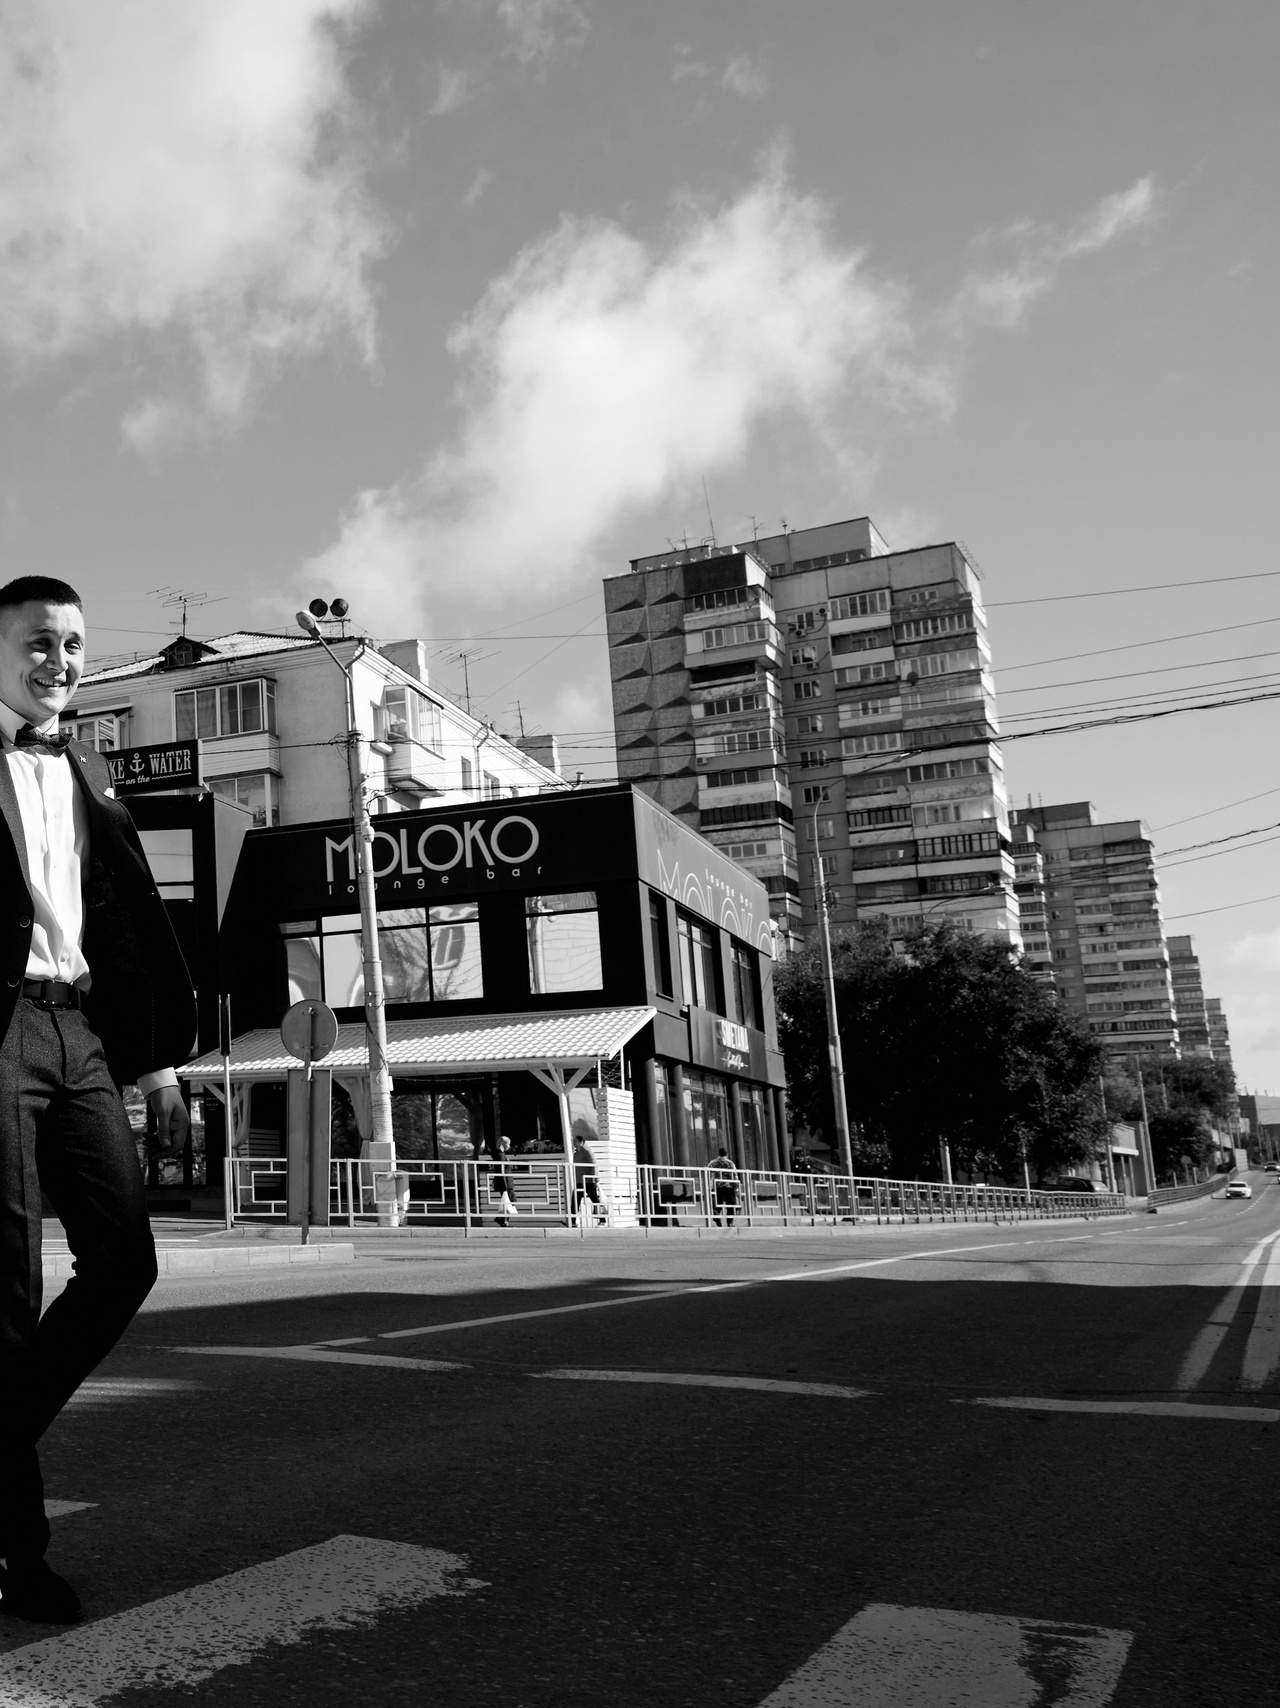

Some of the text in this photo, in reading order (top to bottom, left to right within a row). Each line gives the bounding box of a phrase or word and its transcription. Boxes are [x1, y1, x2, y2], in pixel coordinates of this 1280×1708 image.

[149, 749, 192, 774] WATER
[137, 775, 150, 783] the
[325, 816, 540, 882] MOLOKO
[486, 866, 543, 880] bar
